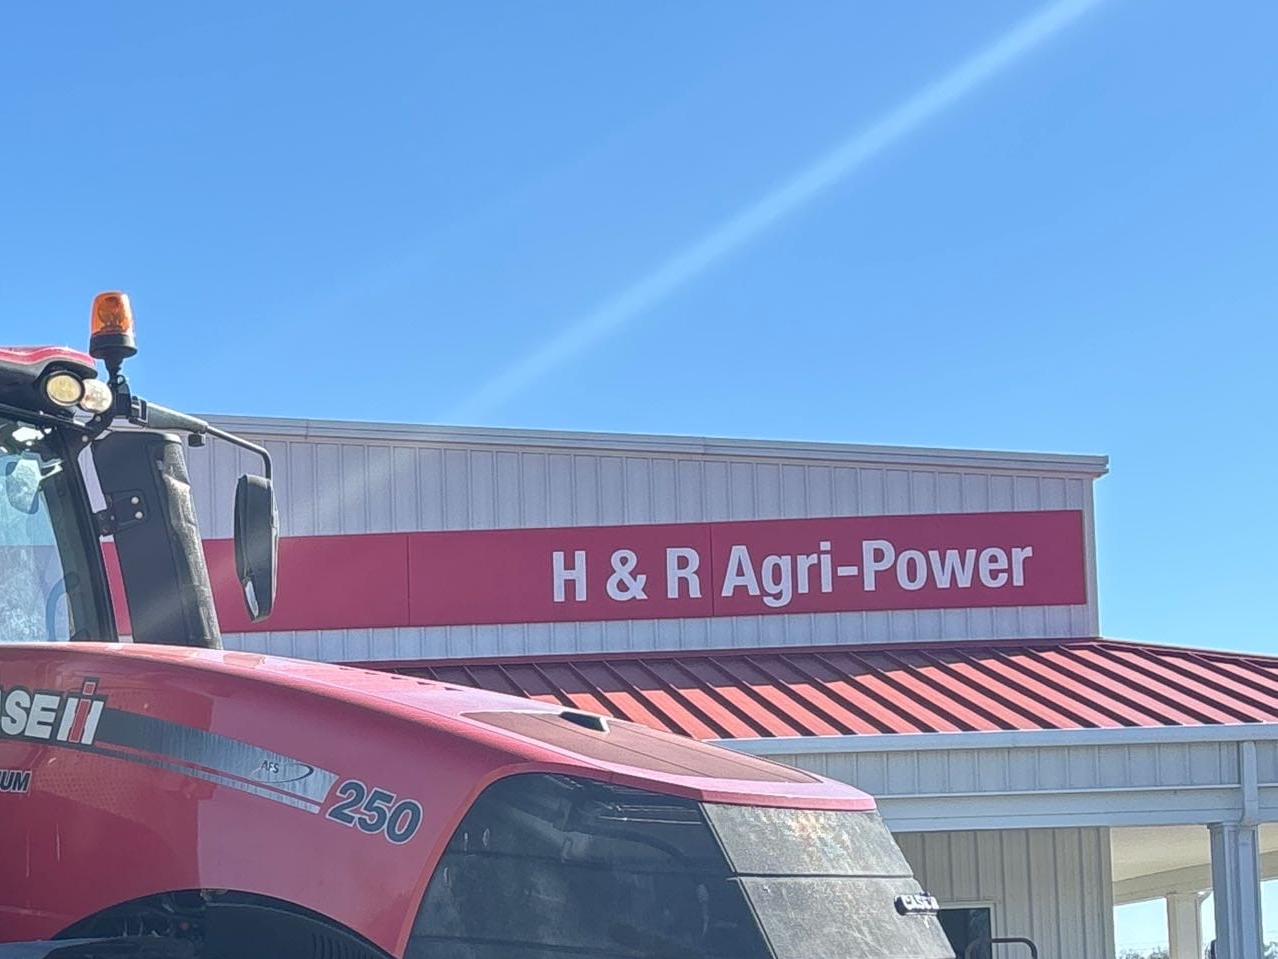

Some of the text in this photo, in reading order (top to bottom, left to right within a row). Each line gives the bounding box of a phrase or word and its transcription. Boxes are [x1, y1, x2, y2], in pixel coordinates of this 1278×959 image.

[552, 539, 1033, 608] H & R Agri-Power
[260, 759, 280, 774] AFS
[325, 779, 424, 845] 250
